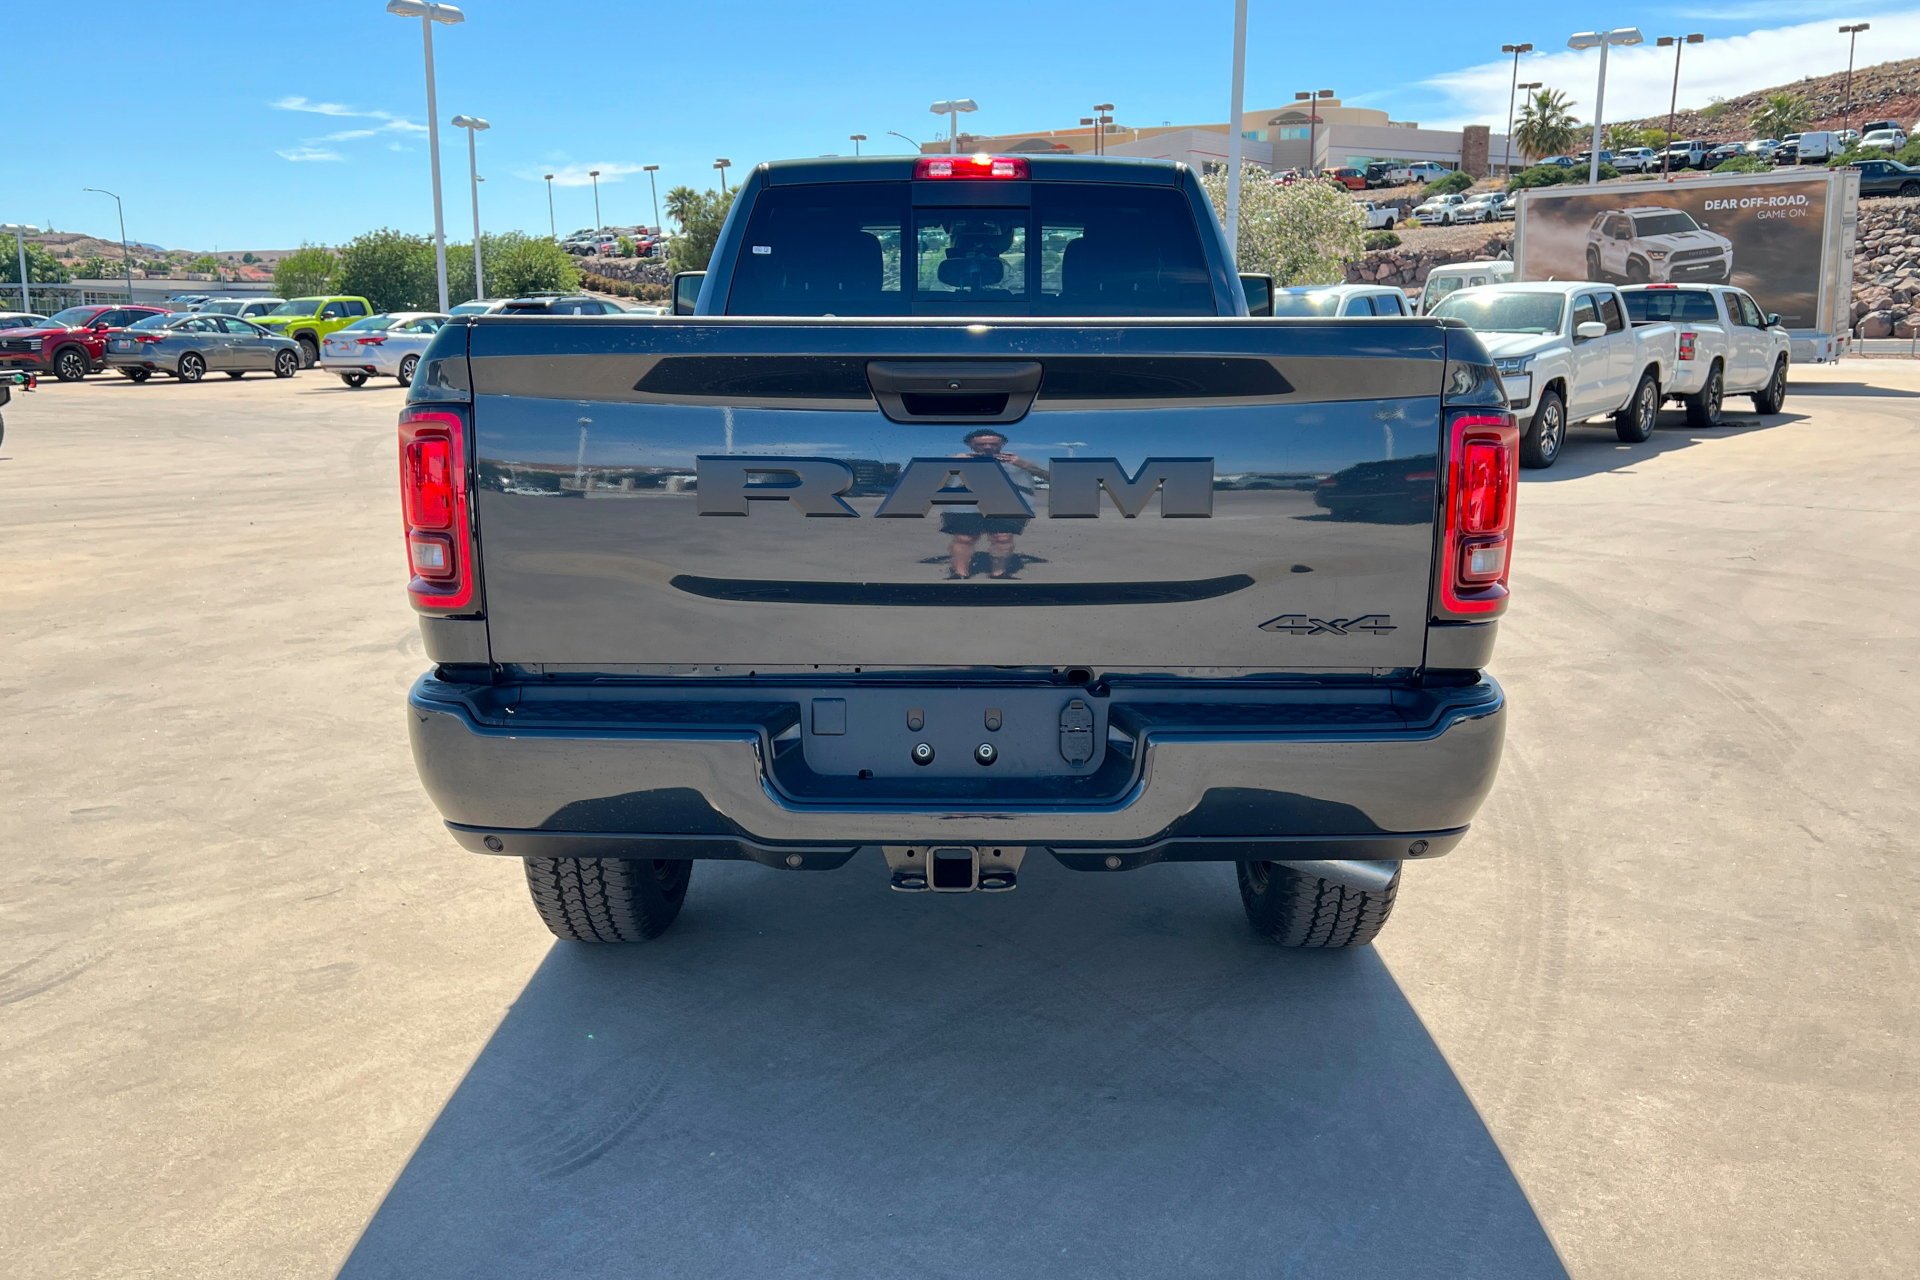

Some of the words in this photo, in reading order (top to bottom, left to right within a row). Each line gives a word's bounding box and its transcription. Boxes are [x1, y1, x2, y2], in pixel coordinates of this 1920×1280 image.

[1704, 198, 1738, 210] DEAR
[1739, 194, 1809, 208] OFF-ROAD,
[1757, 209, 1786, 220] GAME
[1788, 208, 1809, 218] ON.
[696, 455, 1215, 518] RAM
